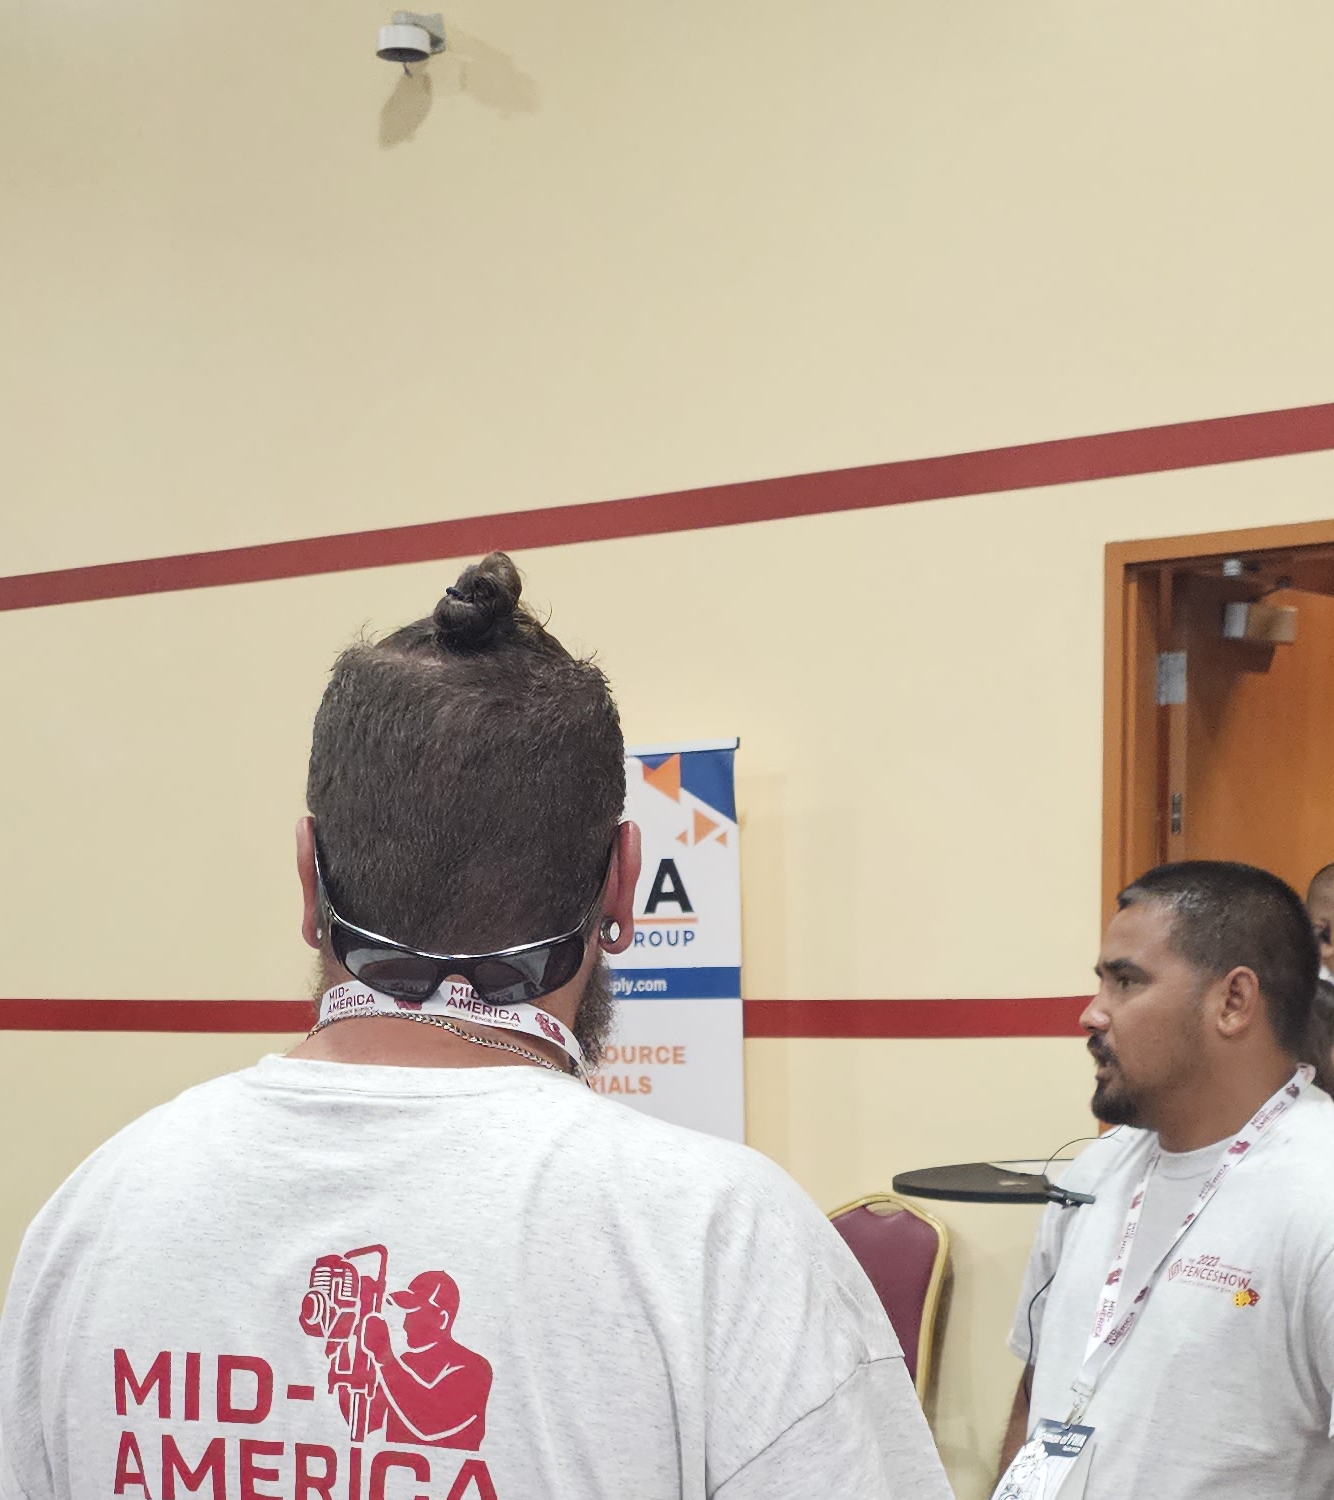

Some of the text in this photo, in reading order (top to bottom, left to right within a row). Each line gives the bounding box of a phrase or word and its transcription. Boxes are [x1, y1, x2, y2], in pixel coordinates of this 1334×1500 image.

[634, 930, 695, 947] ROUP
[328, 993, 376, 1014] AMERICA
[329, 986, 349, 1000] MID-
[446, 997, 521, 1023] AMERICA
[604, 1045, 686, 1064] OURCE
[1183, 1265, 1252, 1290] FENCESHOW
[114, 1348, 315, 1425] MID-
